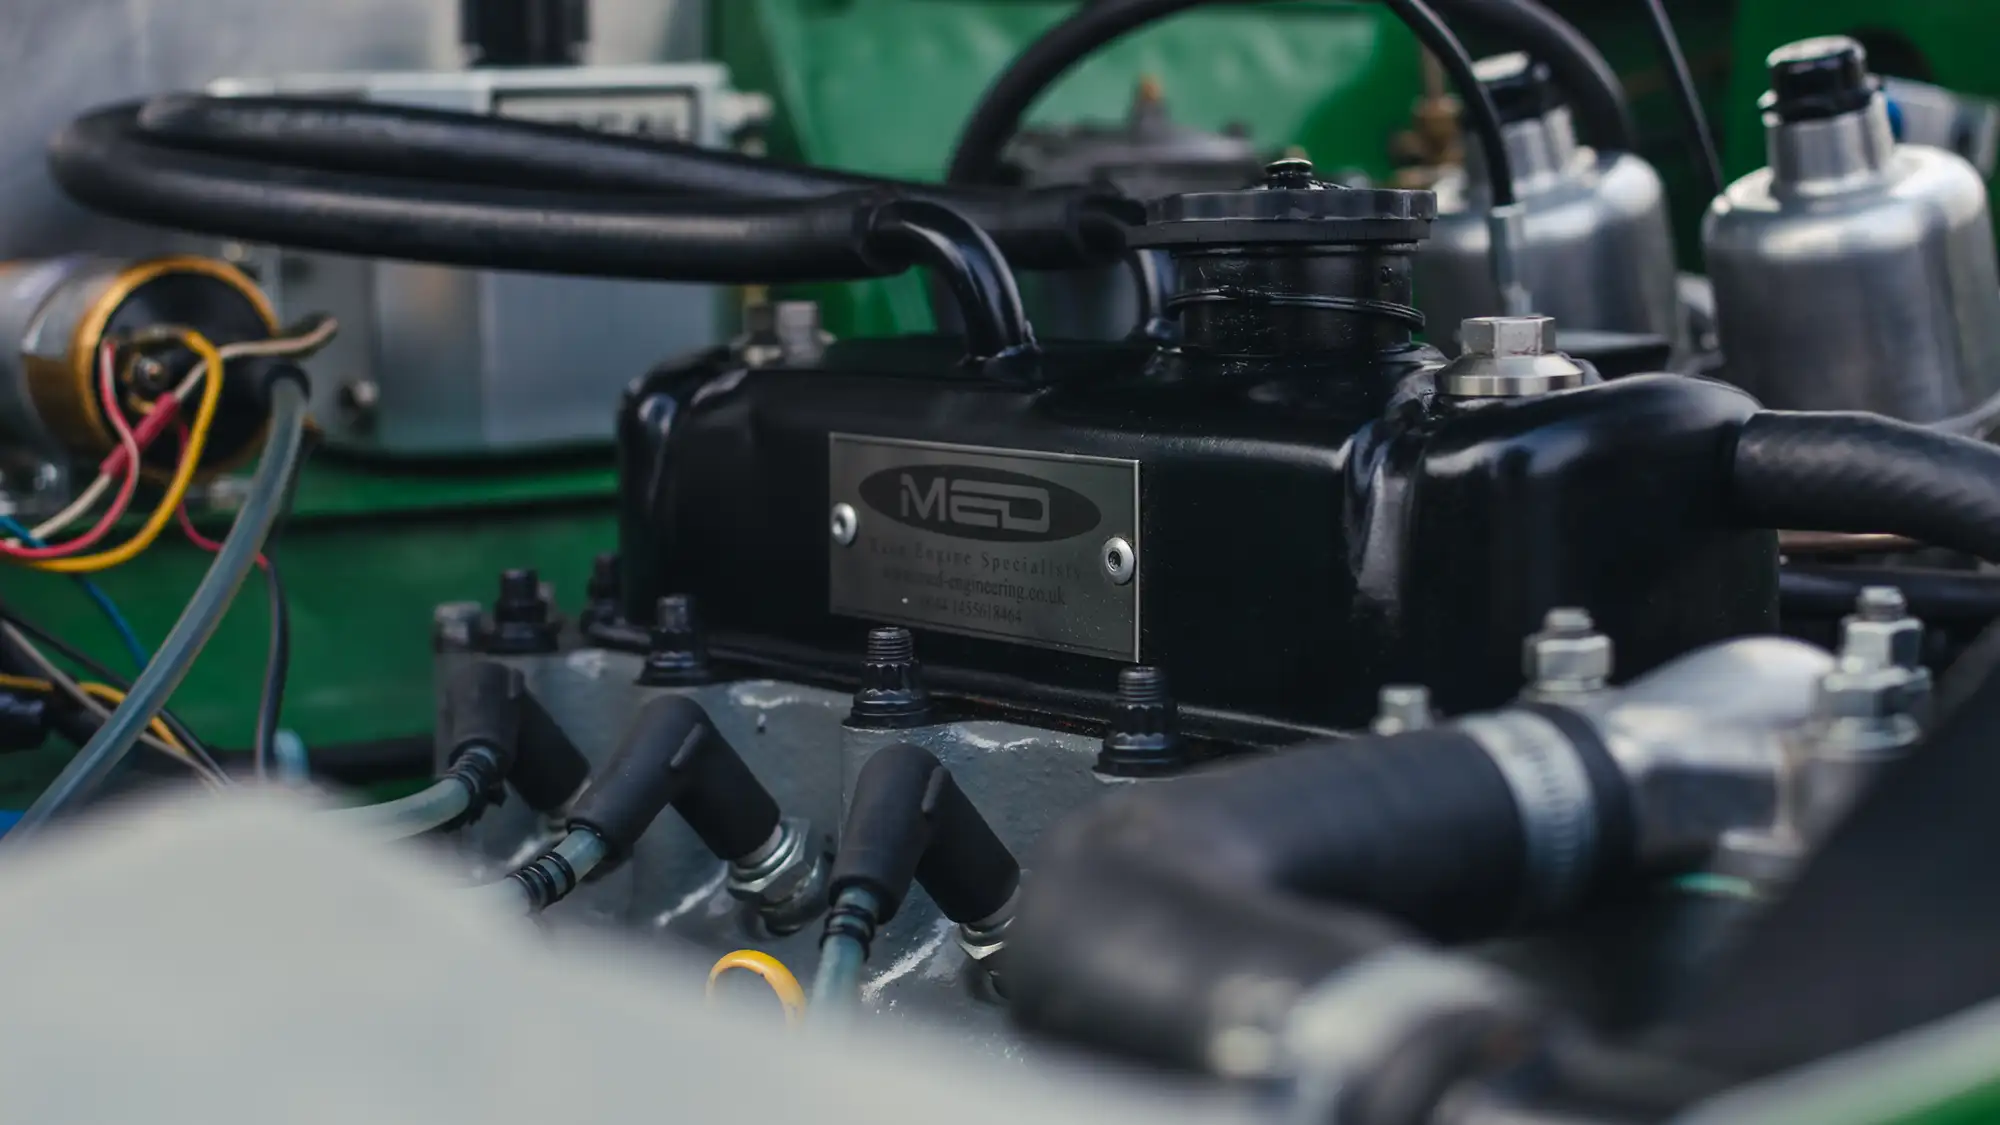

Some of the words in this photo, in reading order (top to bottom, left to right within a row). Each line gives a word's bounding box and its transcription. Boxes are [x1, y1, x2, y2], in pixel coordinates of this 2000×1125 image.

[900, 474, 1050, 533] MED
[915, 541, 972, 567] Engine
[981, 551, 1081, 581] Specialists
[882, 567, 1066, 605] wwwed-engineering.co.uk
